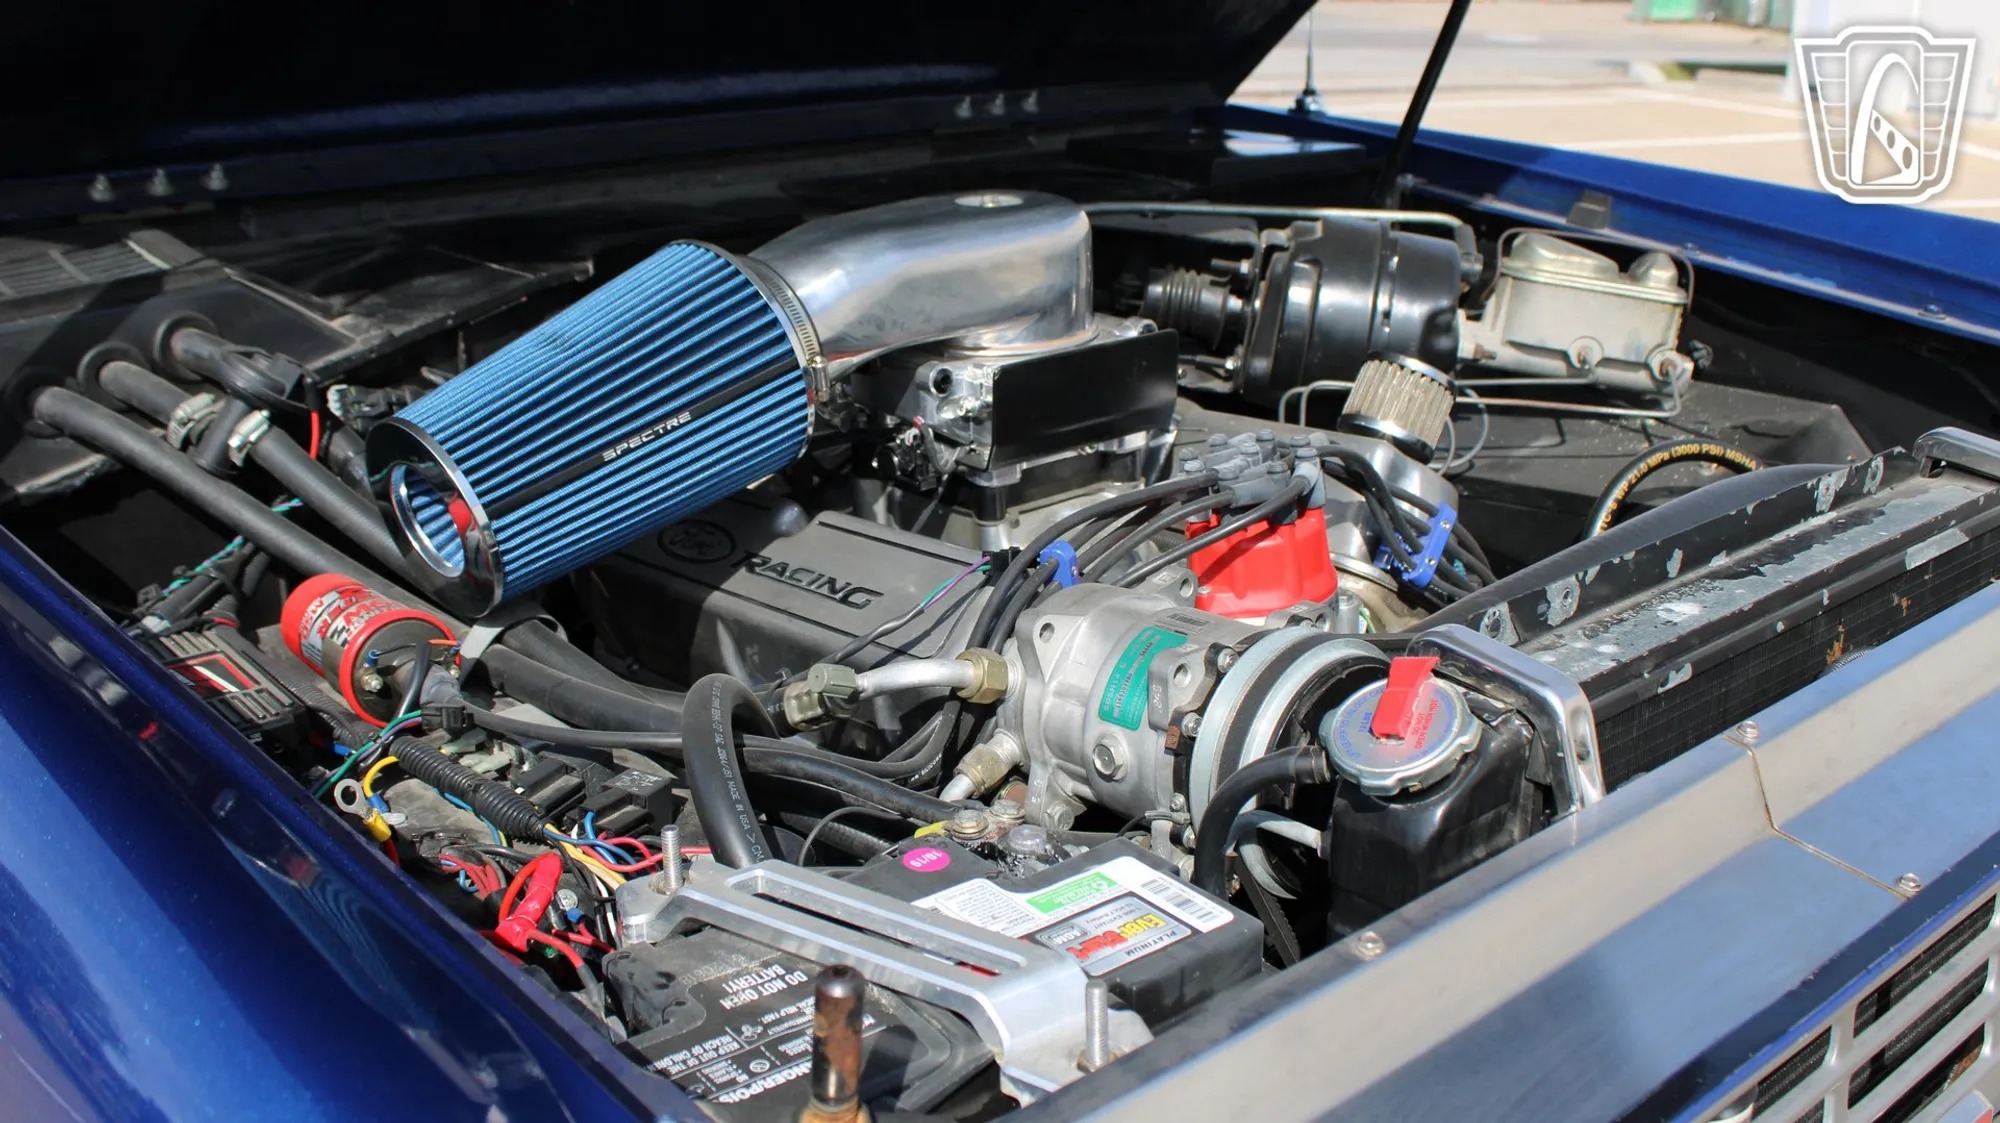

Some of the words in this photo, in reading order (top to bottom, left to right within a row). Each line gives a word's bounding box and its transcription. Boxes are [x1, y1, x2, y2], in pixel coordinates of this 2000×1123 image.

[601, 411, 691, 462] SPECTRE
[1725, 448, 1757, 470] MSHA
[733, 551, 884, 610] RACING
[726, 780, 740, 800] MADE
[739, 813, 751, 830] USA
[1051, 928, 1081, 945] AGM
[1123, 929, 1177, 957] PLATINUM
[720, 963, 785, 993] BATTERY!
[757, 977, 787, 996] NOT
[783, 969, 809, 986] DO
[718, 988, 758, 1009] OPEN
[689, 1043, 703, 1056] OF
[701, 1031, 733, 1053] REACH
[715, 1040, 741, 1056] KEEP
[684, 1055, 698, 1068] OF
[697, 1047, 718, 1064] OUT
[666, 1060, 686, 1076] THE
